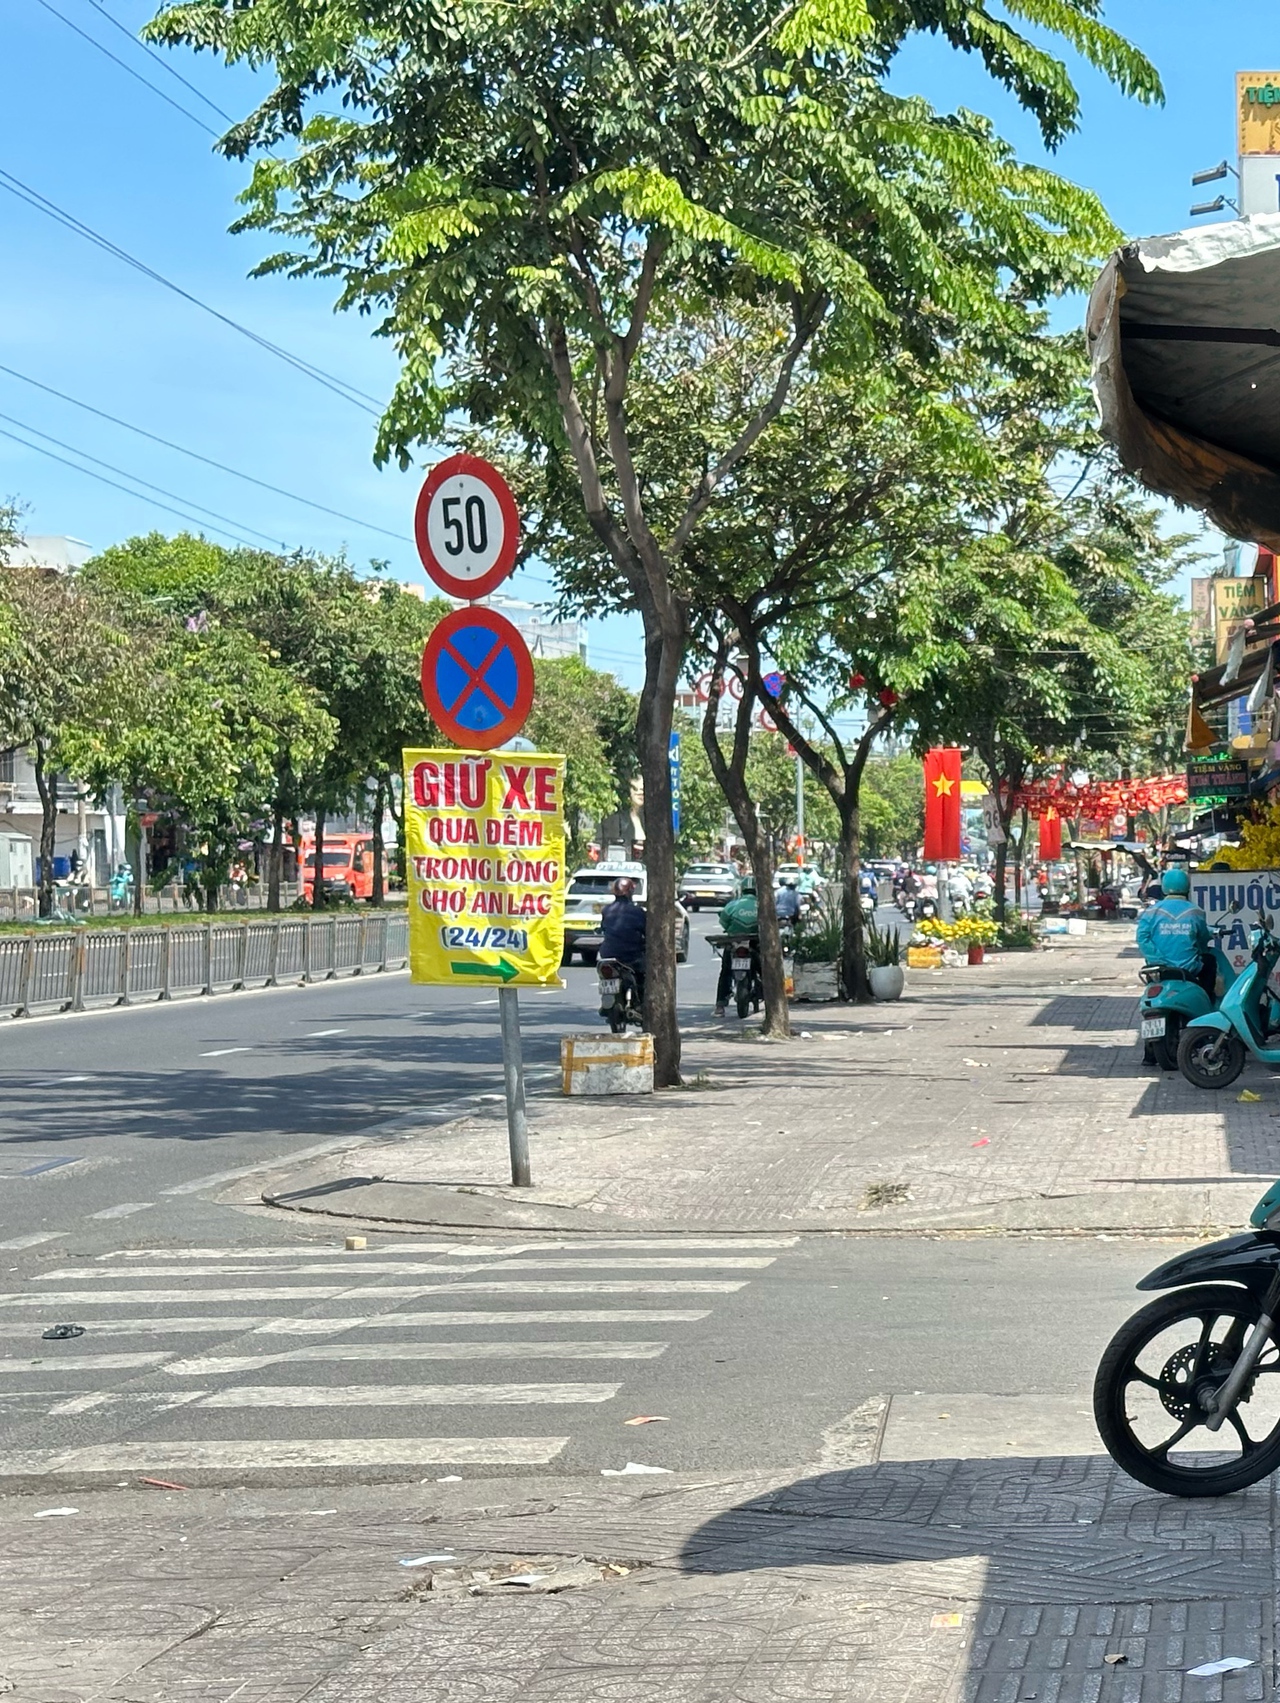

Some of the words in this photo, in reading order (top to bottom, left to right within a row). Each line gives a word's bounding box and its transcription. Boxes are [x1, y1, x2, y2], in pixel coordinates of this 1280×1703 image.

[441, 494, 488, 557] 50
[413, 755, 493, 809] GIỮ
[502, 765, 558, 812] XE
[429, 817, 480, 847] QUA
[486, 814, 543, 847] ĐÊM
[413, 857, 492, 882] TRONG
[496, 853, 558, 883] LÒNG
[422, 887, 467, 918] CHỢ
[471, 891, 503, 914] AN
[508, 893, 552, 920] LẠC
[441, 926, 529, 951] (24/24)
